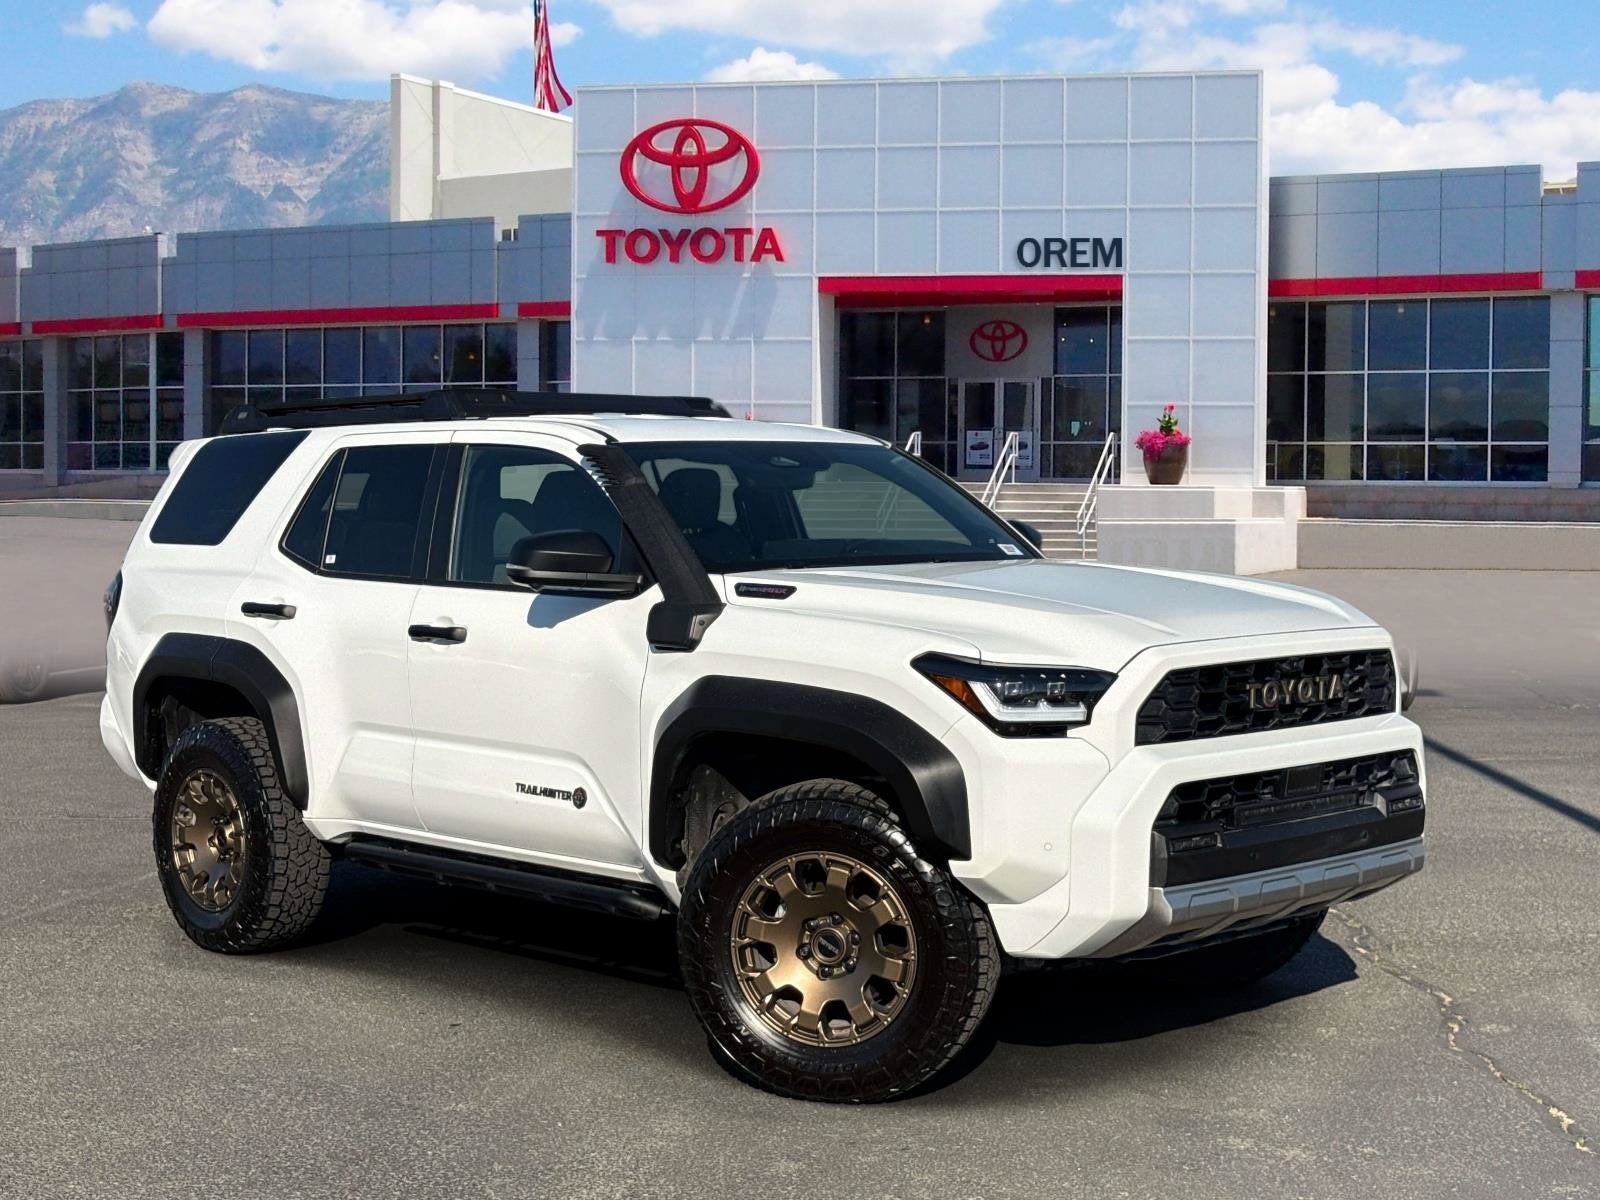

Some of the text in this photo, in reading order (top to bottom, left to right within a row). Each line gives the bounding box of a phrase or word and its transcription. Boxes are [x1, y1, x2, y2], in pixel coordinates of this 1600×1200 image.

[596, 227, 784, 264] TOYOTA
[1017, 237, 1122, 267] OREM
[1246, 674, 1343, 708] TOYOTA
[515, 782, 573, 801] TRAILHUNTER
